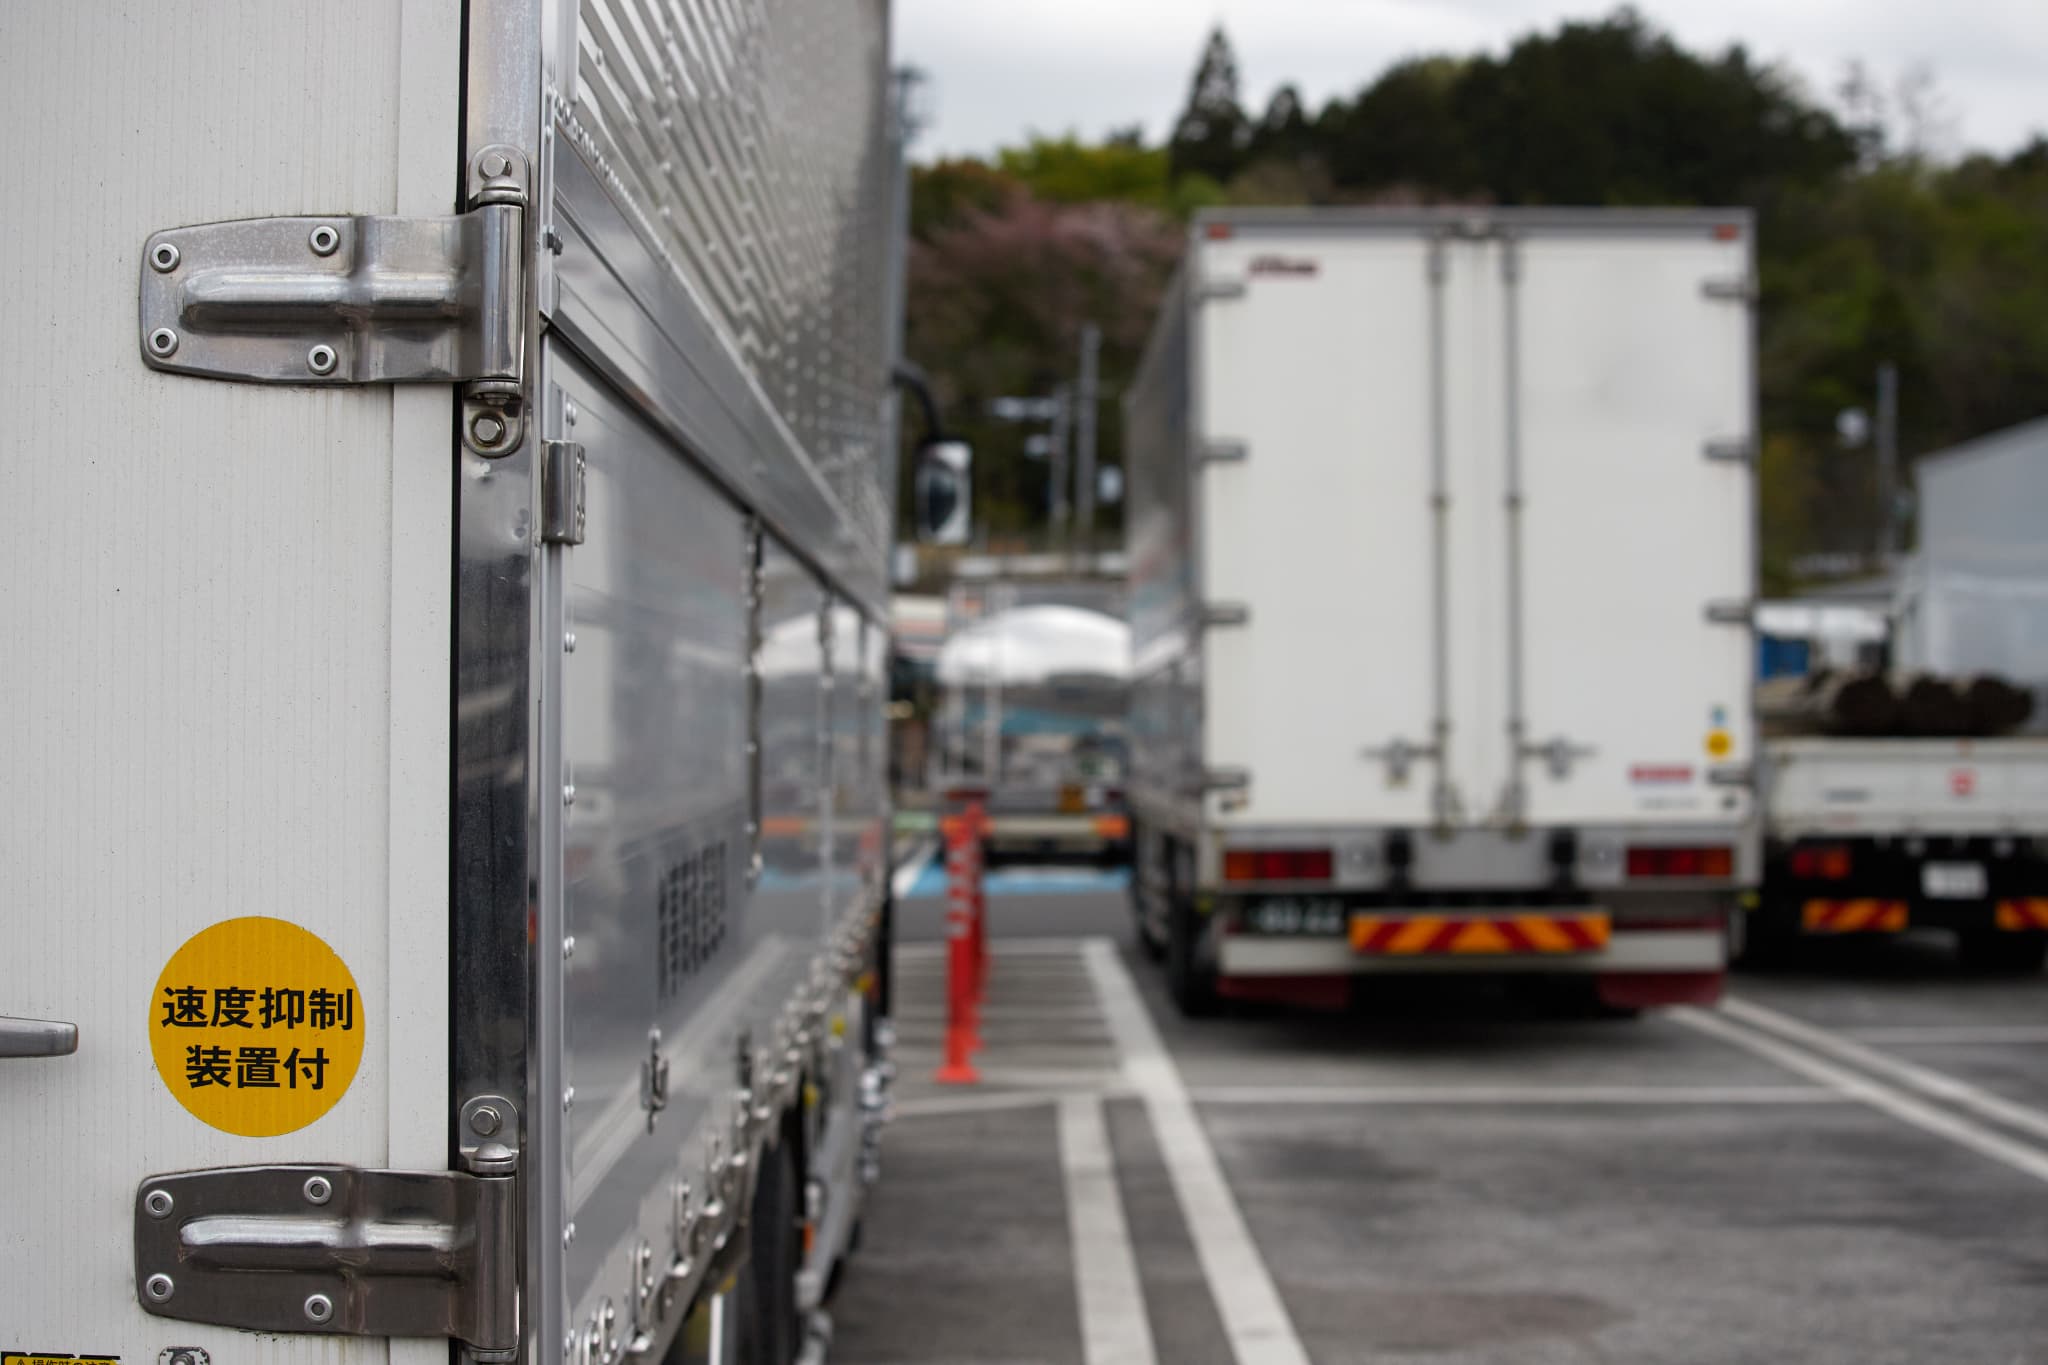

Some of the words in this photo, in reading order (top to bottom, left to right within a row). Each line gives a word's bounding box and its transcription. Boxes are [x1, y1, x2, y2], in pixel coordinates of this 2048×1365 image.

[161, 986, 354, 1030] 速度抑制
[185, 1045, 330, 1090] 装置付
